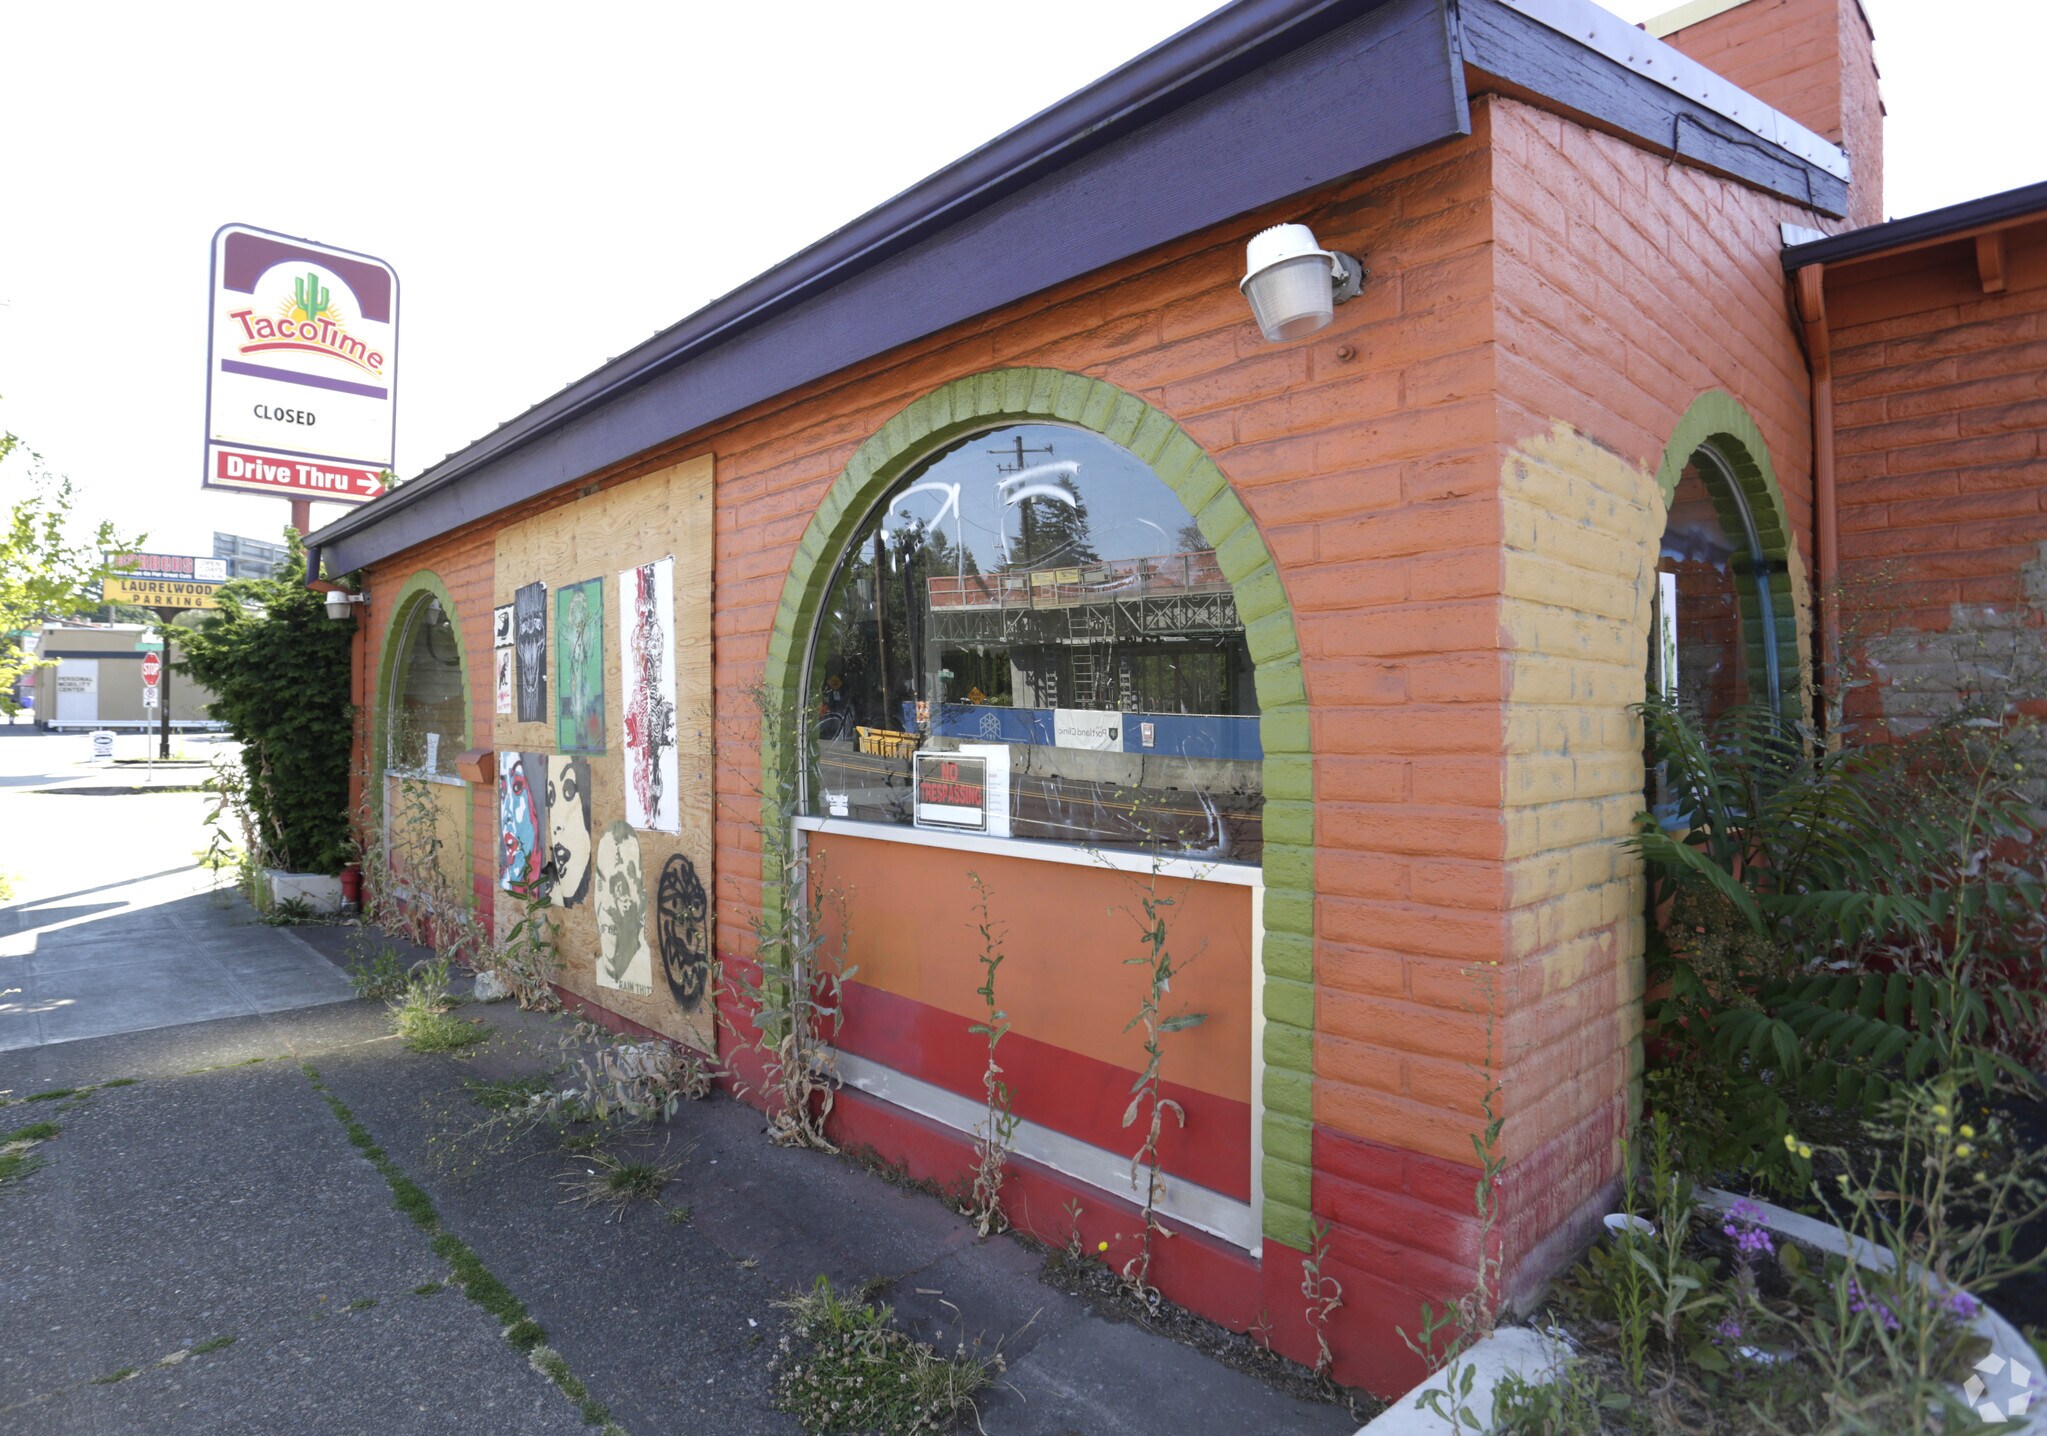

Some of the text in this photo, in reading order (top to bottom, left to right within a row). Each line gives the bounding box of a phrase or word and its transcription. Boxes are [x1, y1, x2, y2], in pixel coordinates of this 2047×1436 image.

[254, 404, 316, 426] CLOSED
[227, 455, 349, 491] Drive Thru
[121, 581, 212, 595] LAURELWOOD
[133, 594, 202, 607] PARKING
[144, 662, 160, 675] STOP
[940, 761, 959, 782] NO
[920, 781, 983, 806] TRESPASSING
